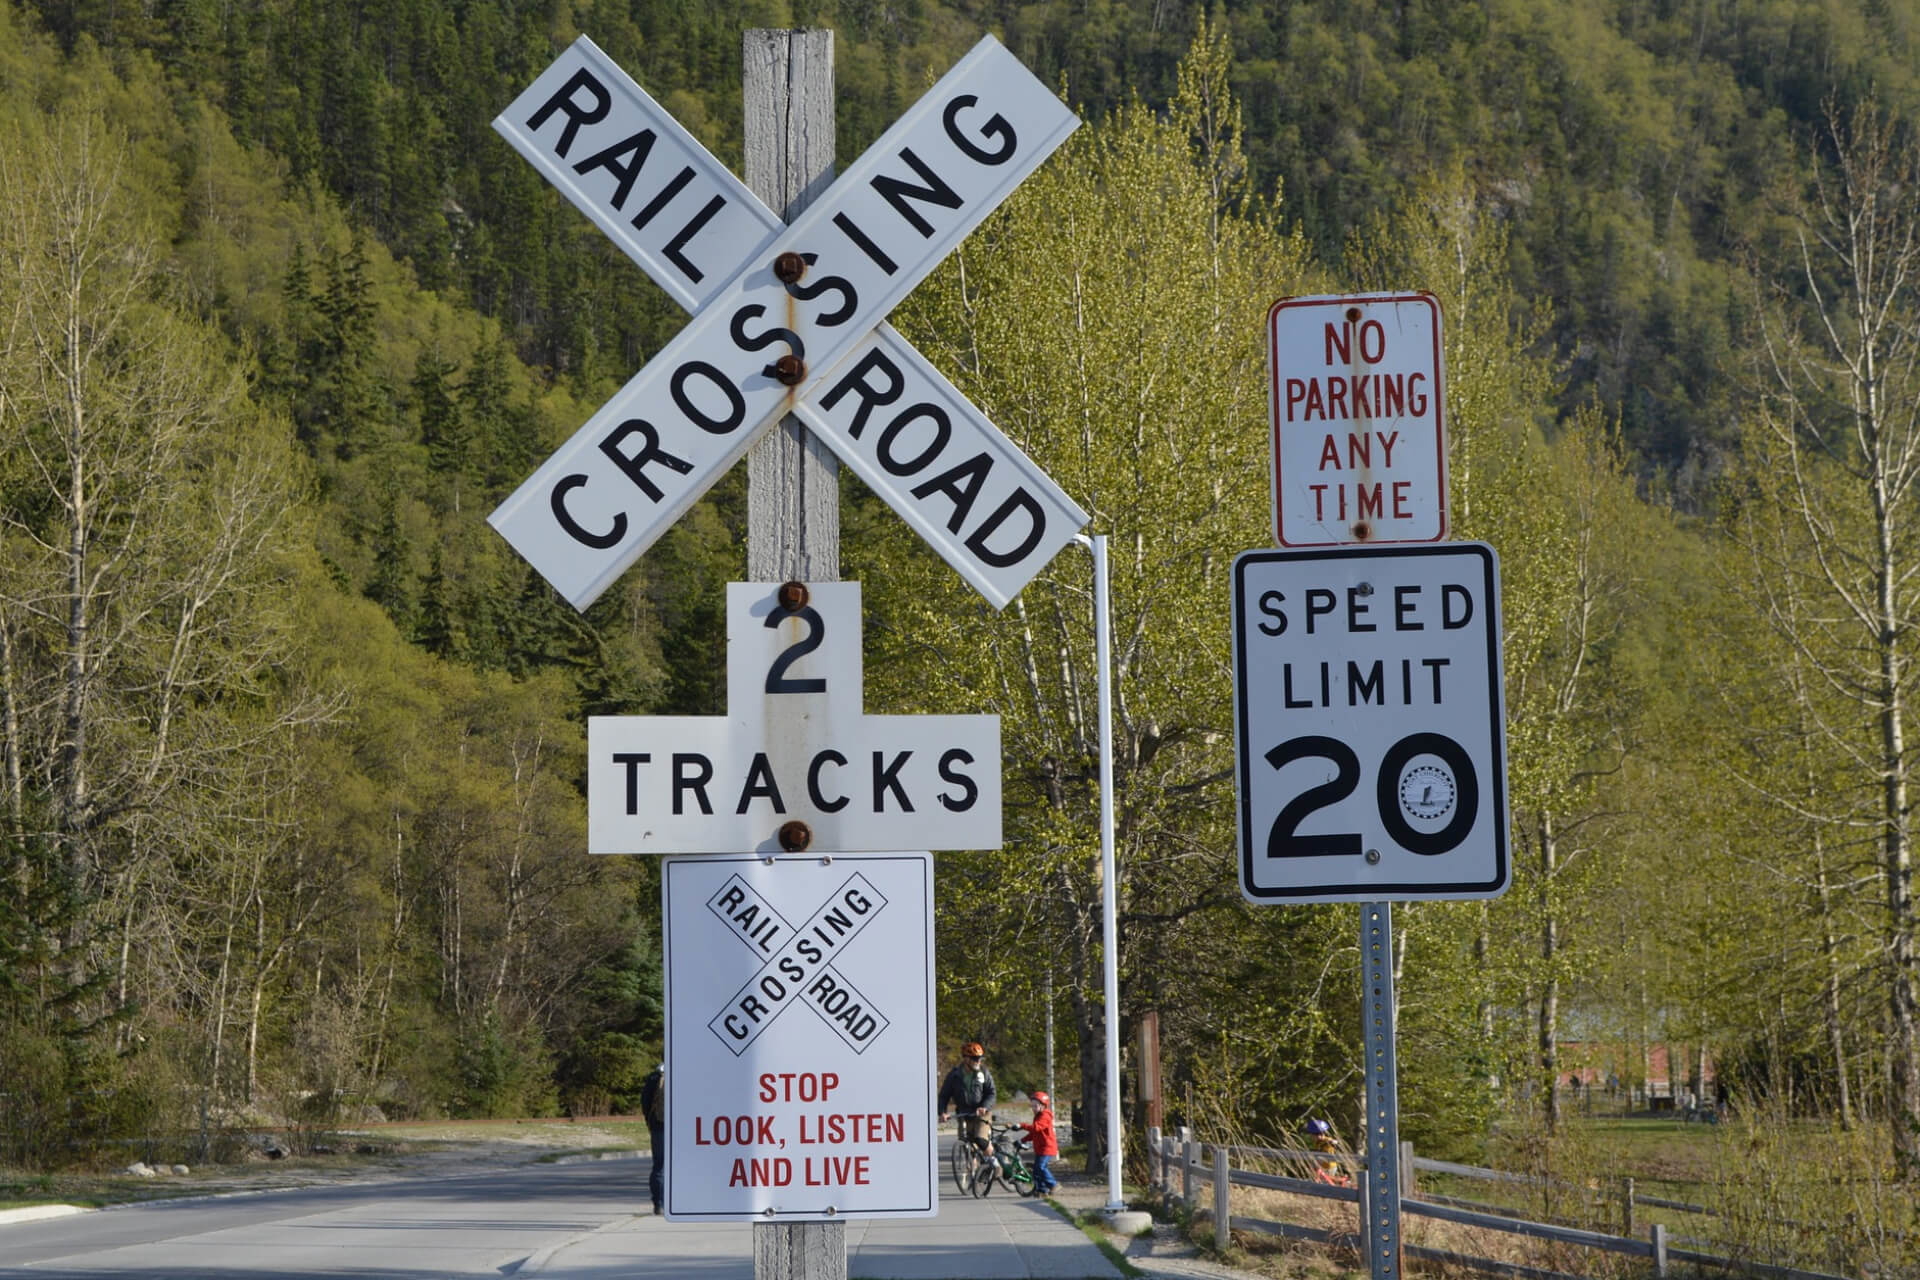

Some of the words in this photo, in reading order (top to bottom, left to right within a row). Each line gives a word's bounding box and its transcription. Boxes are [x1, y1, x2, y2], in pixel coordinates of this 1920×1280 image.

[526, 67, 727, 284] RAIL
[818, 347, 1047, 568] ROAD
[550, 94, 1018, 549] CROSSING
[1325, 320, 1385, 366] NO
[1286, 372, 1427, 422] PARKING
[1319, 431, 1399, 470] ANY
[1309, 481, 1413, 521] TIME
[1258, 584, 1473, 636] SPEED
[763, 604, 827, 694] 2
[1284, 658, 1450, 709] LIMIT
[612, 748, 979, 816] TRACKS
[1264, 732, 1479, 858] 20
[717, 885, 780, 953] RAIL
[808, 973, 877, 1041] ROAD
[723, 889, 873, 1040] CROSSING
[759, 1072, 839, 1103] STOP
[695, 1115, 786, 1149] LOOK,
[800, 1113, 905, 1144] LISTEN
[729, 1157, 792, 1187] AND
[805, 1156, 871, 1186] LIVE
